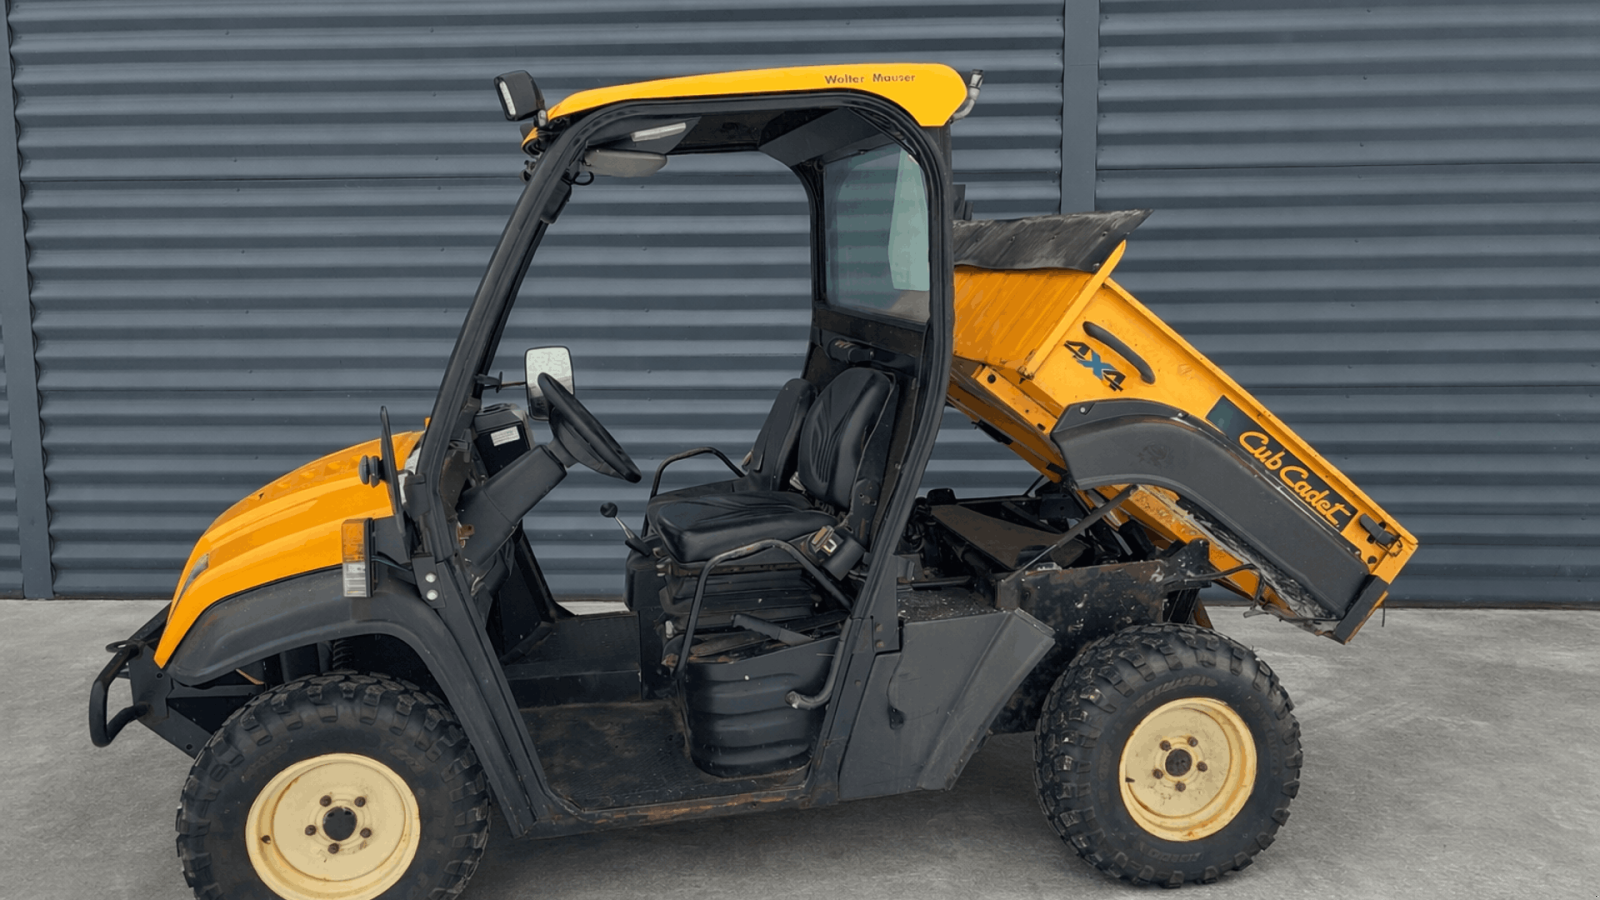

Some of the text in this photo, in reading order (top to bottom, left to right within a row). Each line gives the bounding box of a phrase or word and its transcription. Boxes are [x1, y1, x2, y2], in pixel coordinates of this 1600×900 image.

[872, 73, 916, 83] Mauser
[1239, 431, 1352, 527] Cub Cadet
